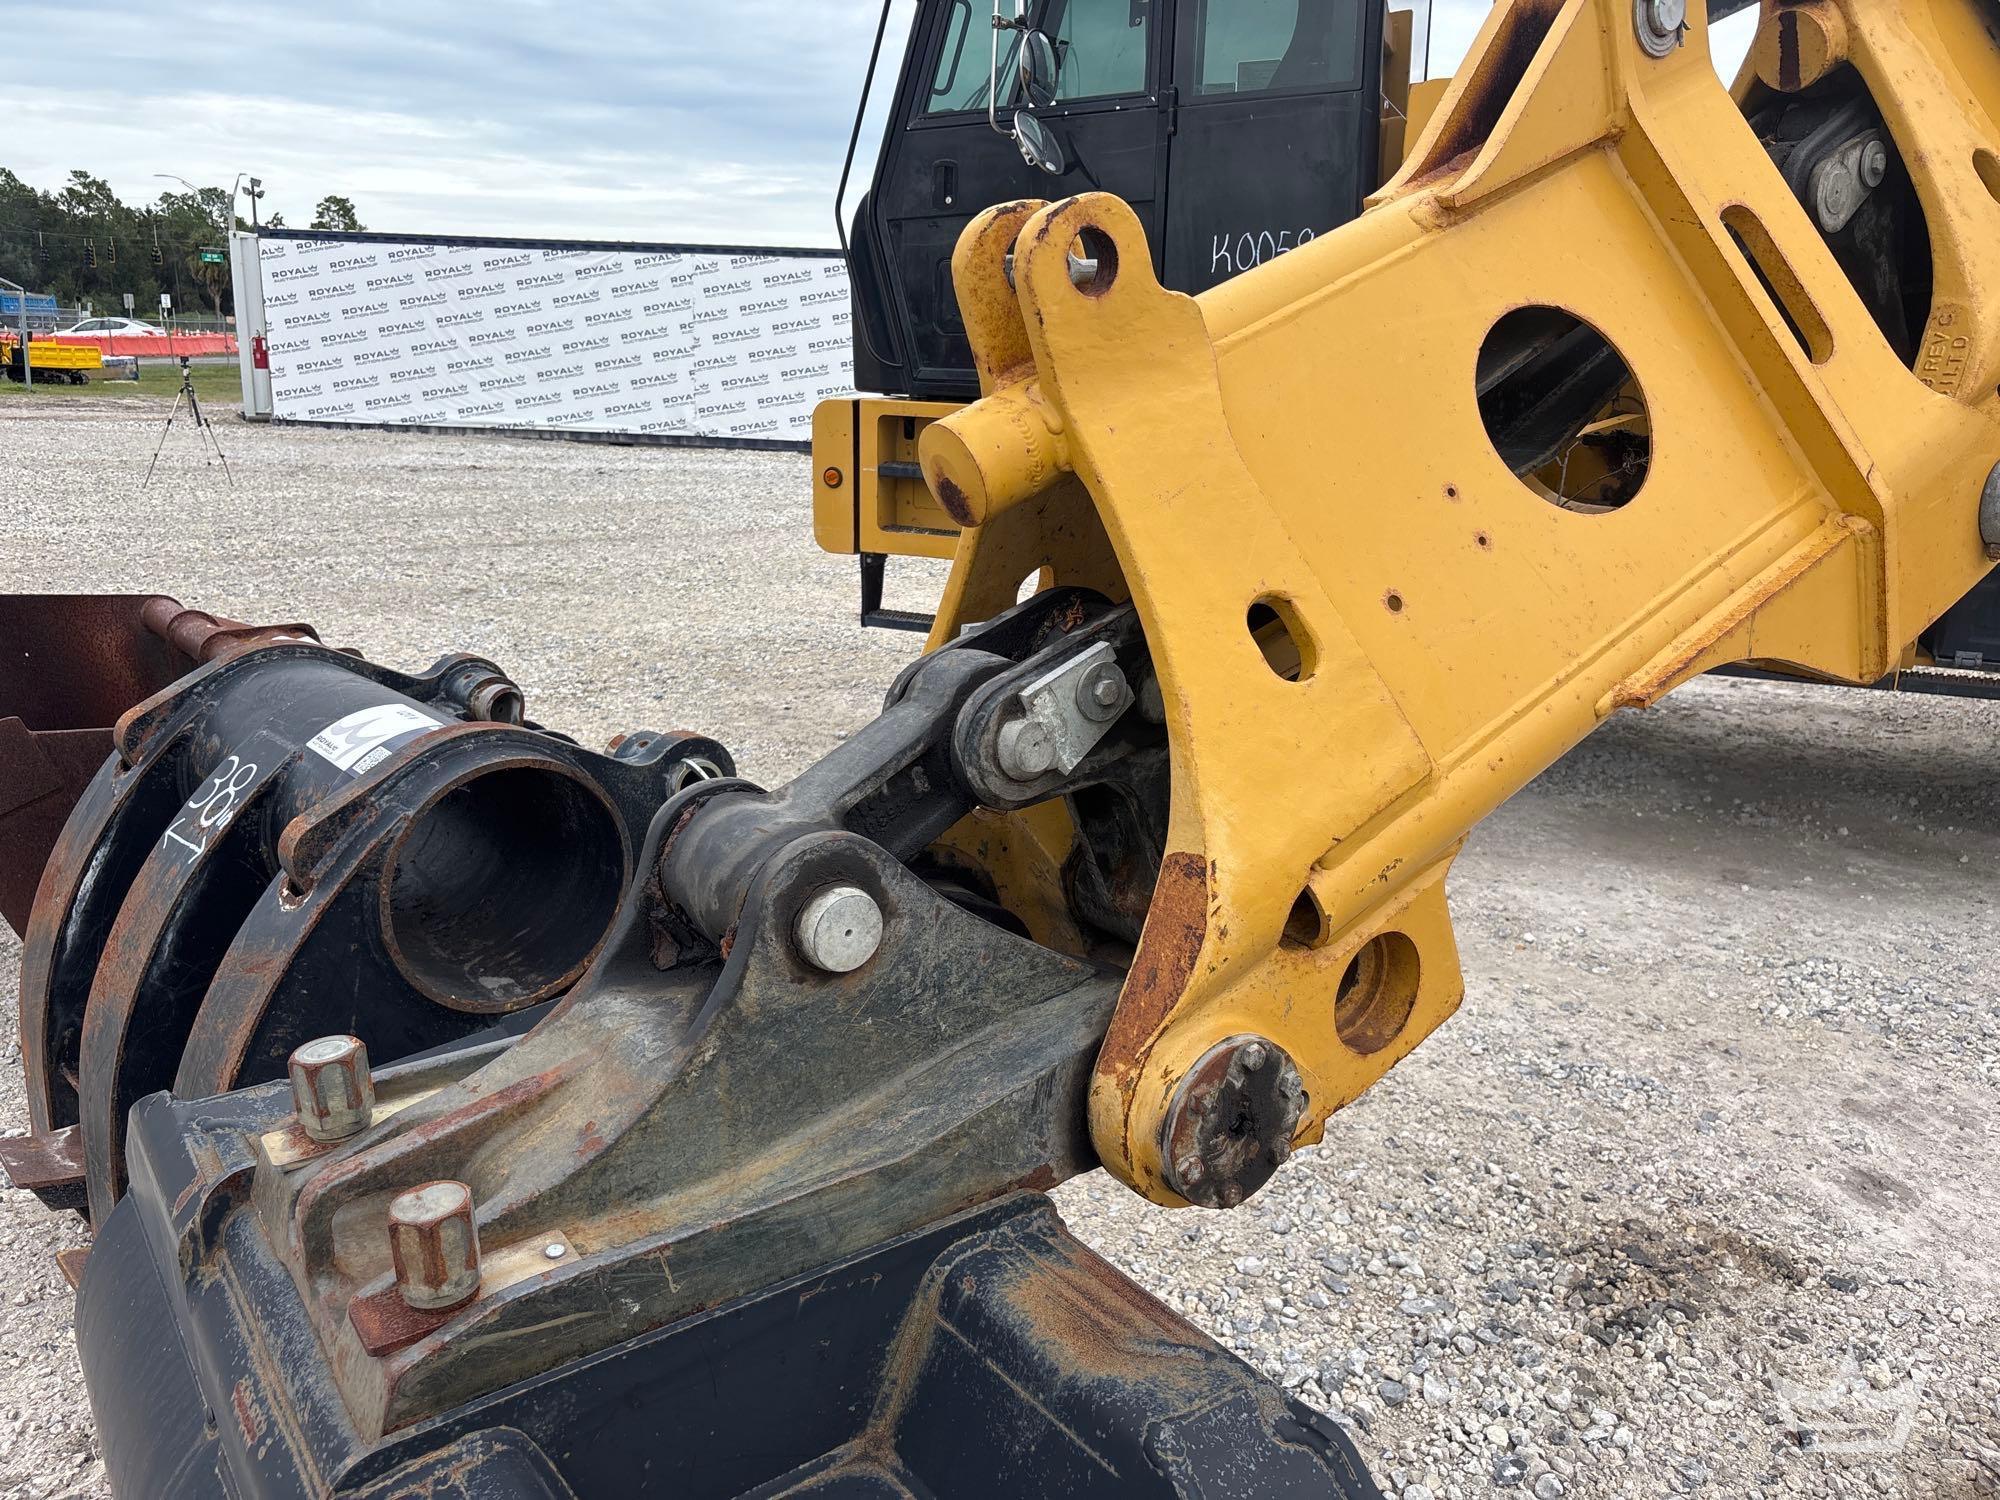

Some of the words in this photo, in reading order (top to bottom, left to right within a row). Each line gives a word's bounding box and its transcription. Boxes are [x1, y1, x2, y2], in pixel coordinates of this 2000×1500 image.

[389, 248, 425, 259] ROYAL
[330, 258, 367, 269] ROYAL
[484, 257, 520, 268] ROYAL
[634, 254, 672, 266] ROYAL
[272, 267, 308, 279] ROYAL
[425, 266, 462, 277] ROYAL
[575, 265, 612, 276] ROYAL
[824, 264, 848, 275] ROY
[367, 276, 403, 287] ROYAL
[517, 275, 554, 286] ROYAL
[671, 274, 694, 284] ROY
[764, 273, 801, 284] ROYAL
[309, 286, 345, 297] ROYAL
[458, 285, 495, 296] ROYAL
[612, 282, 648, 294] ROYAL
[703, 283, 741, 294] ROYAL
[400, 295, 436, 306] ROYAL
[553, 293, 589, 304] ROYAL
[801, 291, 837, 302] ROYAL
[342, 304, 378, 316] ROYAL
[494, 303, 531, 314] ROYAL
[644, 301, 681, 312] ROYAL
[740, 301, 777, 312] ROYAL
[284, 314, 321, 325] ROYAL
[436, 313, 473, 324] ROYAL
[585, 311, 622, 323] ROYAL
[379, 323, 415, 334] ROYAL
[527, 322, 563, 333] ROYAL
[772, 320, 810, 331] ROYAL
[321, 332, 357, 343] ROYAL
[469, 331, 505, 343] ROYAL
[621, 329, 658, 340] ROYAL
[712, 330, 750, 341] ROYAL
[411, 341, 448, 352] ROYAL
[563, 339, 599, 350] ROYAL
[808, 338, 846, 350] ROYAL
[354, 351, 390, 361] ROYAL
[505, 349, 541, 360] ROYAL
[653, 347, 690, 359] ROYAL
[749, 348, 786, 359] ROYAL
[1923, 331, 1950, 371] REV
[297, 360, 333, 371] ROYAL
[447, 359, 483, 370] ROYAL
[595, 357, 631, 369] ROYAL
[390, 368, 426, 379] ROYAL
[537, 367, 573, 378] ROYAL
[781, 367, 818, 378] ROYAL
[333, 378, 369, 388] ROYAL
[480, 377, 516, 388] ROYAL
[631, 375, 667, 386] ROYAL
[722, 376, 759, 387] ROYAL
[276, 387, 312, 398] ROYAL
[422, 387, 458, 397] ROYAL
[573, 385, 609, 396] ROYAL
[816, 384, 854, 396] ROYAL
[365, 396, 401, 407] ROYAL
[515, 394, 551, 405] ROYAL
[662, 394, 693, 405] ROYA
[758, 394, 795, 405] ROYAL
[309, 405, 345, 416] ROYAL
[458, 404, 494, 415] ROYAL
[605, 403, 641, 414] ROYAL
[699, 403, 735, 414] ROYAL
[401, 413, 437, 424] ROYAL
[548, 412, 584, 423] ROYAL
[789, 414, 813, 424] ROY
[640, 420, 677, 431] ROYAL
[731, 422, 767, 433] ROYAL
